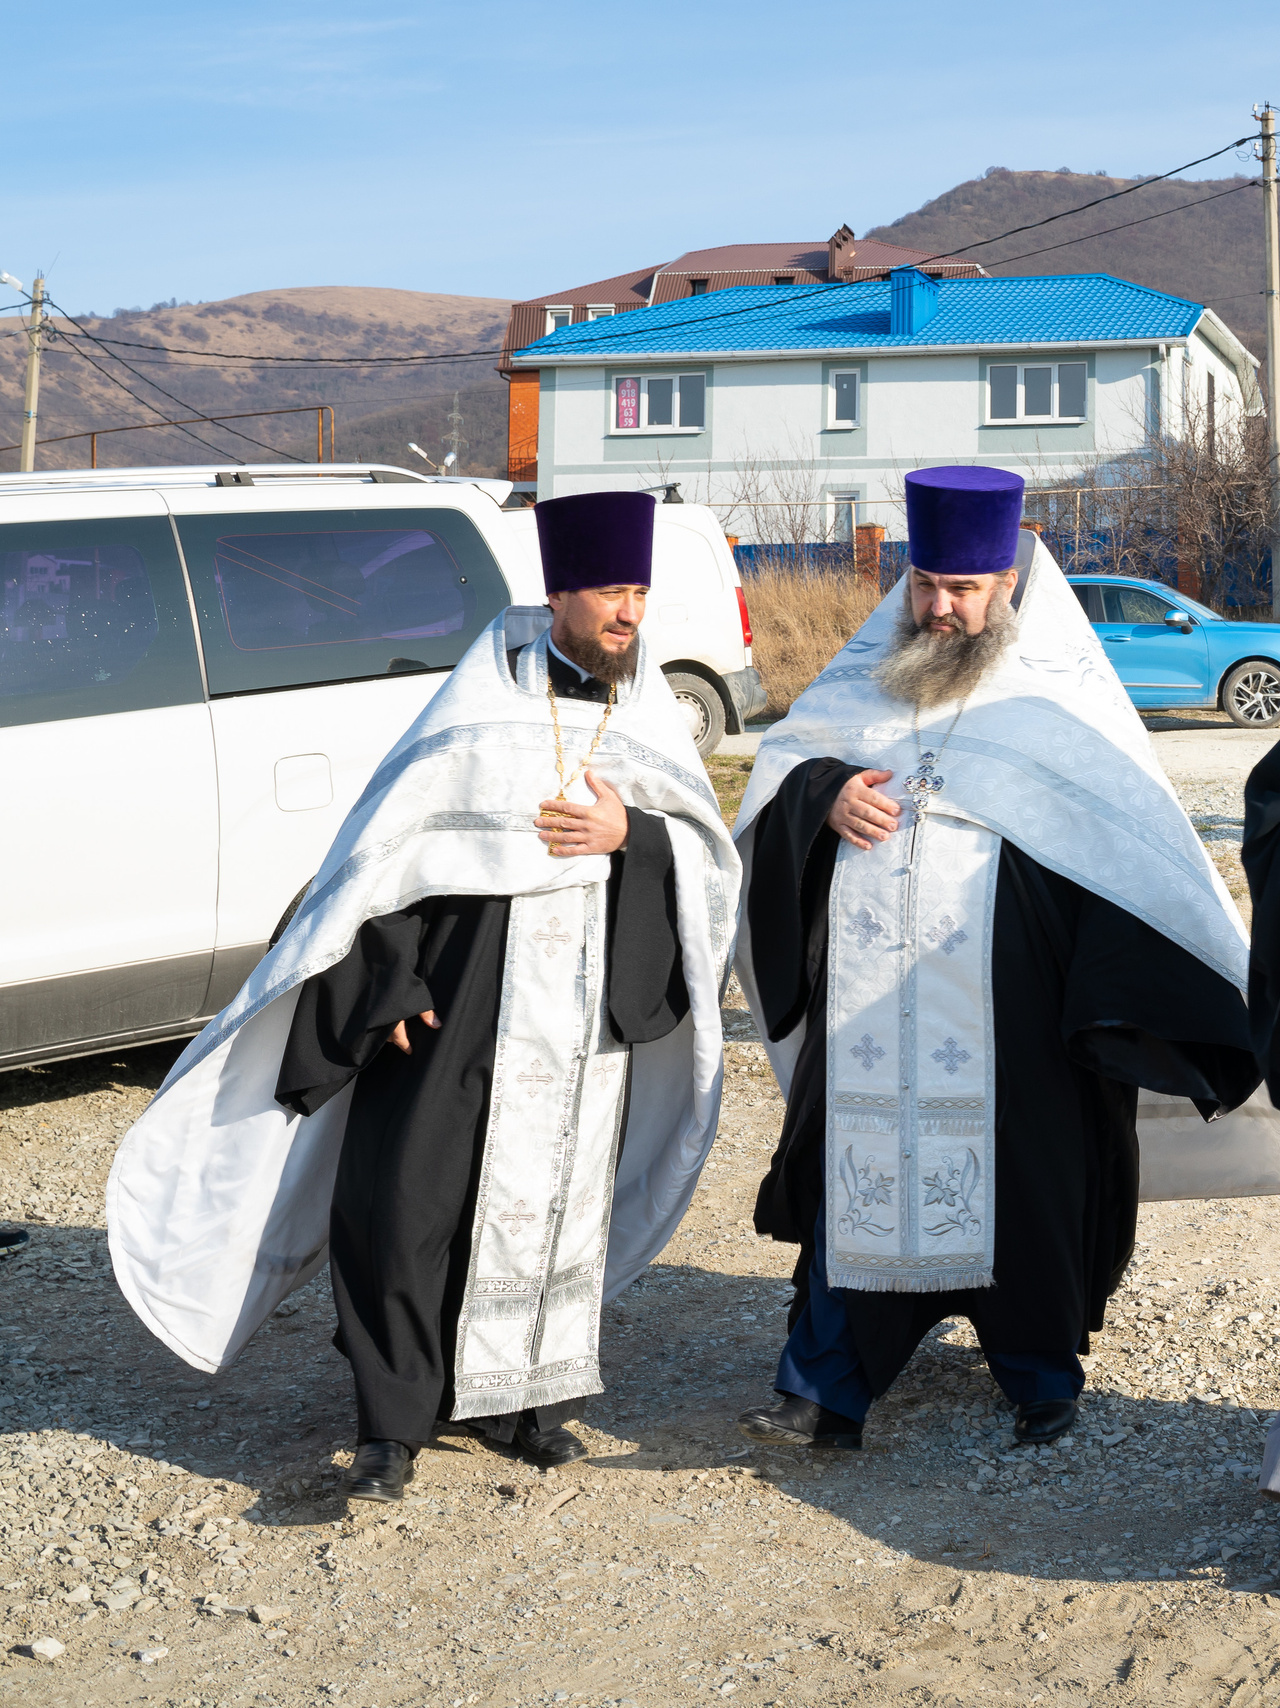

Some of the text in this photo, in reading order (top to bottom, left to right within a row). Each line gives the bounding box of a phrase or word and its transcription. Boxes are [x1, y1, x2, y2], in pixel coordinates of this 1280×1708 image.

[626, 379, 631, 388] 8
[621, 389, 636, 397] 918
[621, 399, 636, 407] 419
[624, 408, 633, 417] 63
[624, 418, 633, 427] 59
